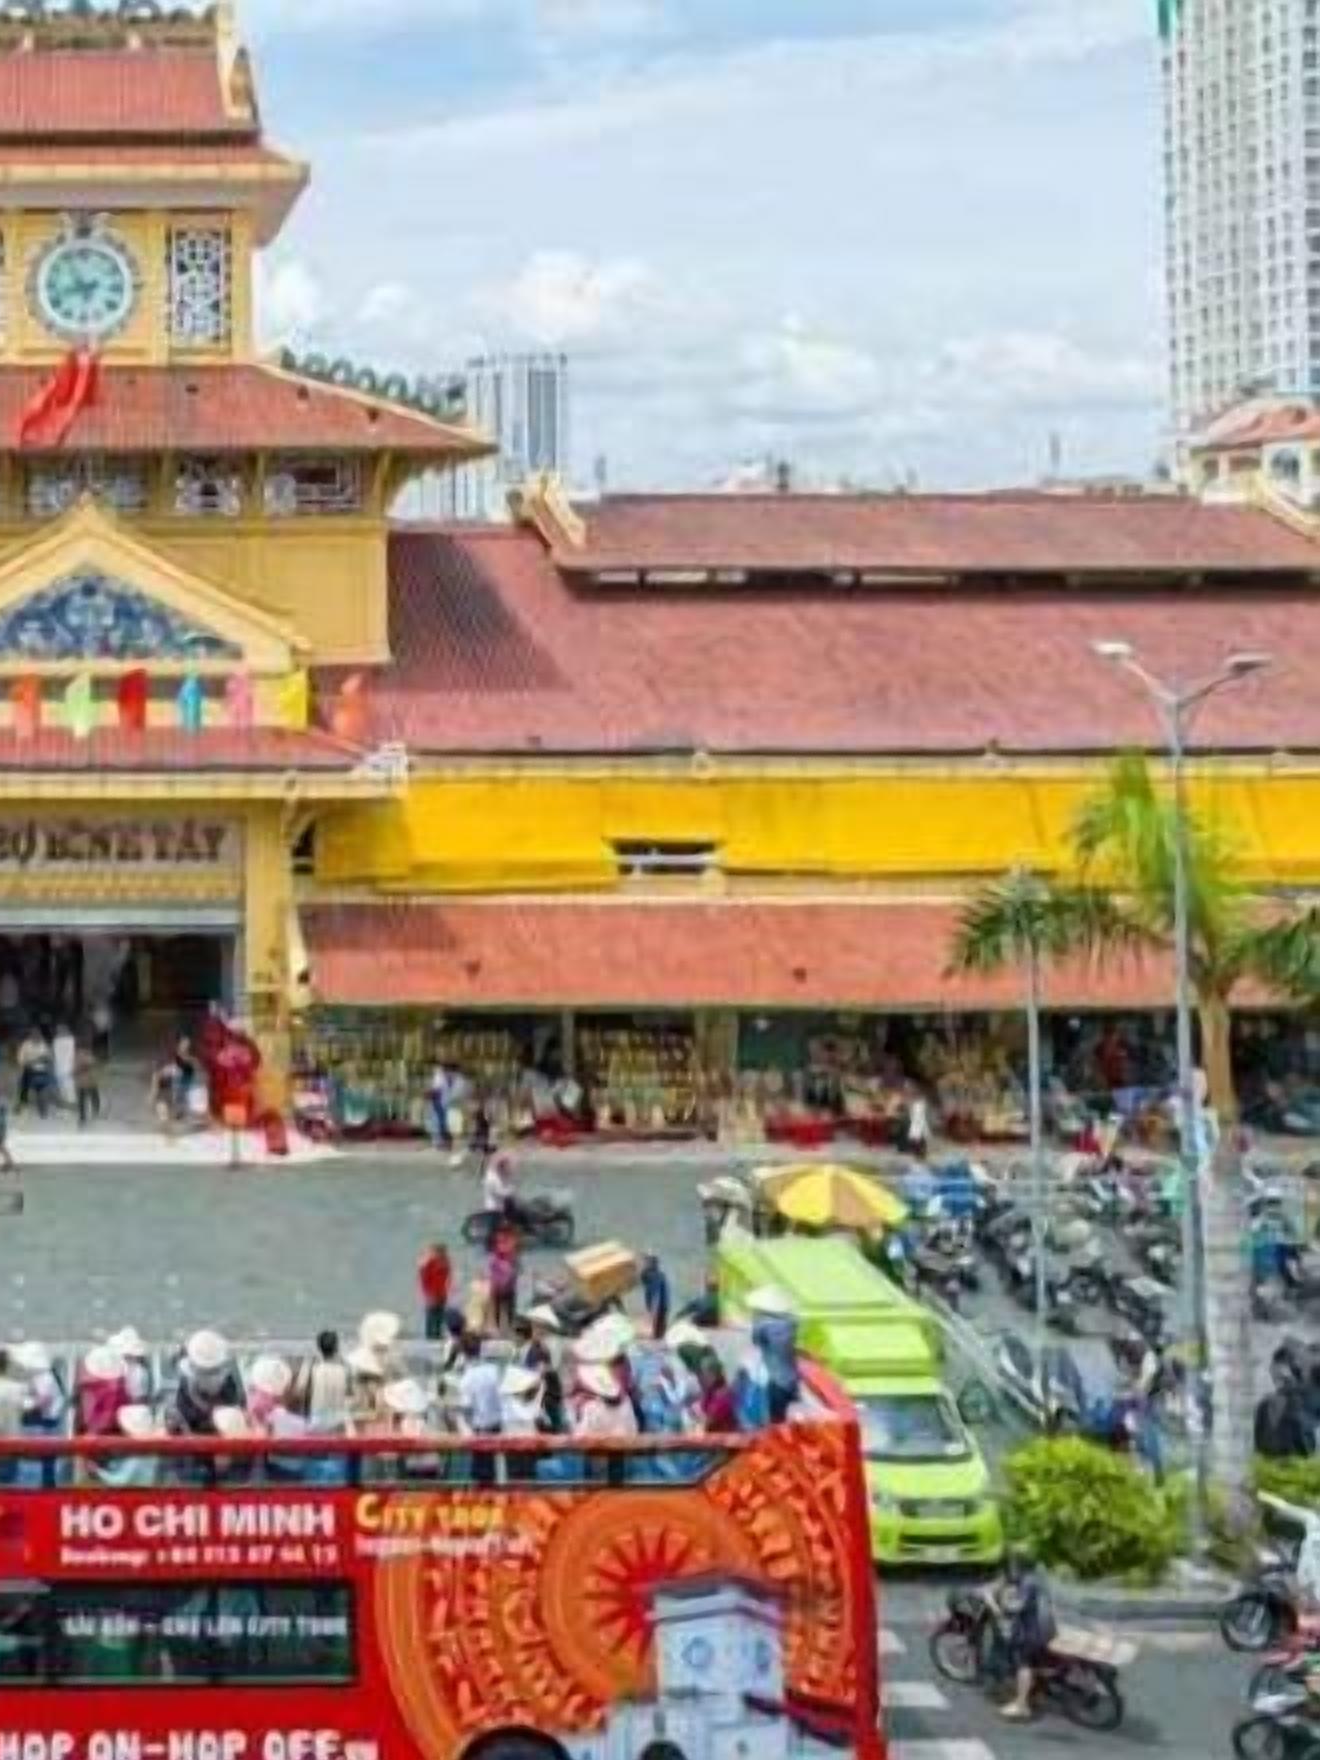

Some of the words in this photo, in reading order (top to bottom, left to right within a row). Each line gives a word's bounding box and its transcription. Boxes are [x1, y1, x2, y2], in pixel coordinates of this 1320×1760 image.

[59, 1504, 123, 1538] HO
[134, 1504, 208, 1538] CHI
[220, 1504, 336, 1537] MINH
